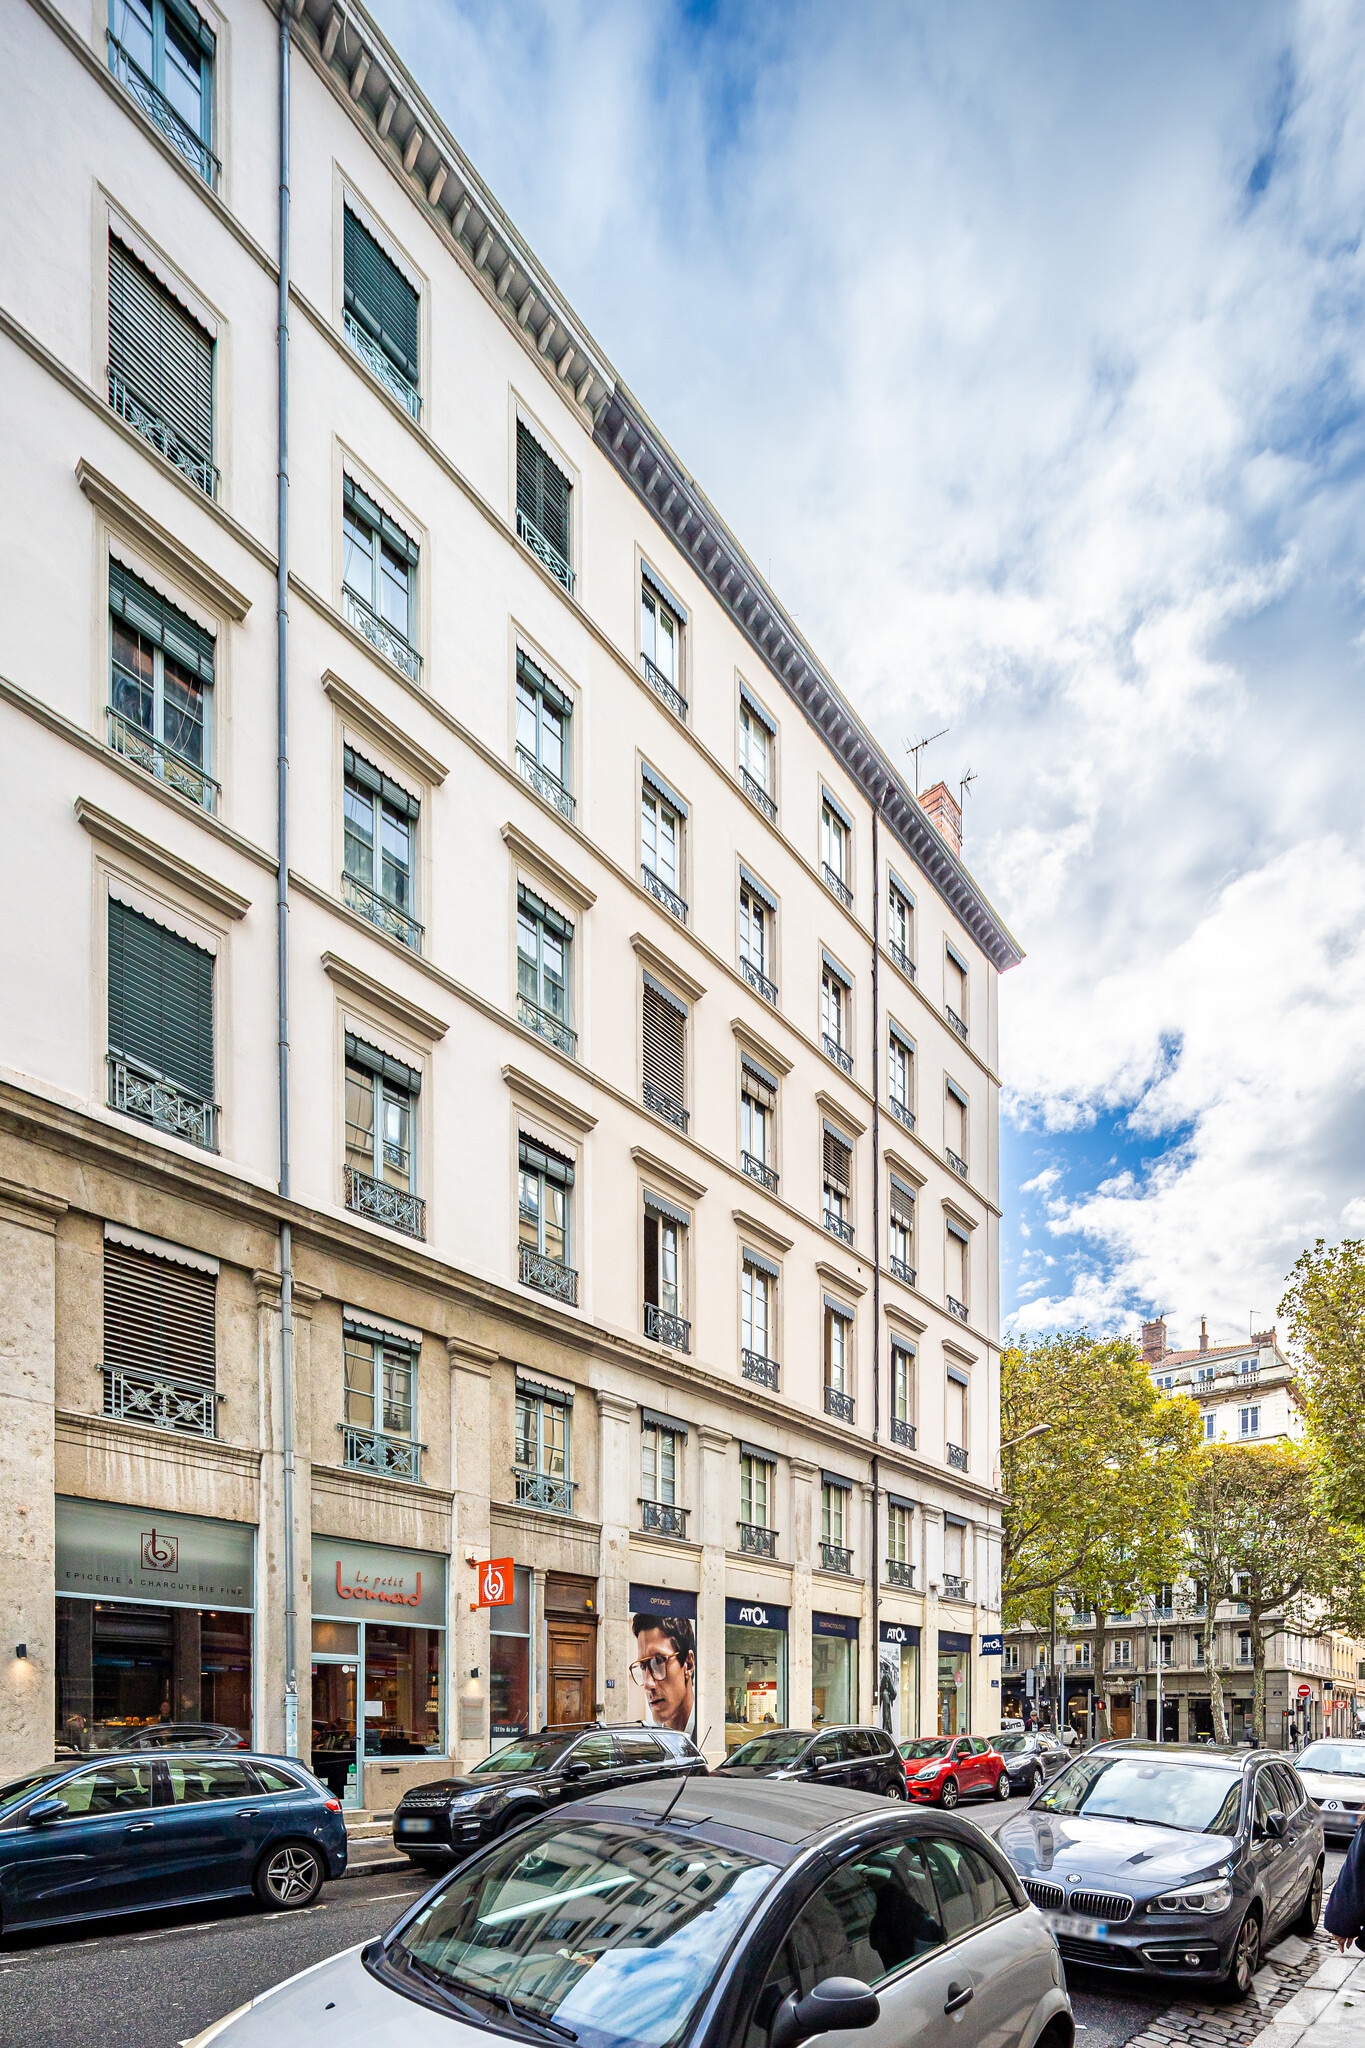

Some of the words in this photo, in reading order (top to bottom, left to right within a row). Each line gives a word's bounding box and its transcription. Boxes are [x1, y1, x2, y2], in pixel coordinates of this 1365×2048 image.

[66, 1571, 121, 1584] EPICERIE
[140, 1579, 215, 1593] CHARCUTERIE
[335, 1560, 422, 1607] bonnard
[356, 1570, 368, 1582] Le
[373, 1575, 405, 1590] petit
[649, 1597, 671, 1607] OPTIQUE
[739, 1606, 769, 1626] ATOL
[886, 1626, 908, 1643] ATOL
[982, 1639, 1002, 1649] ATOL
